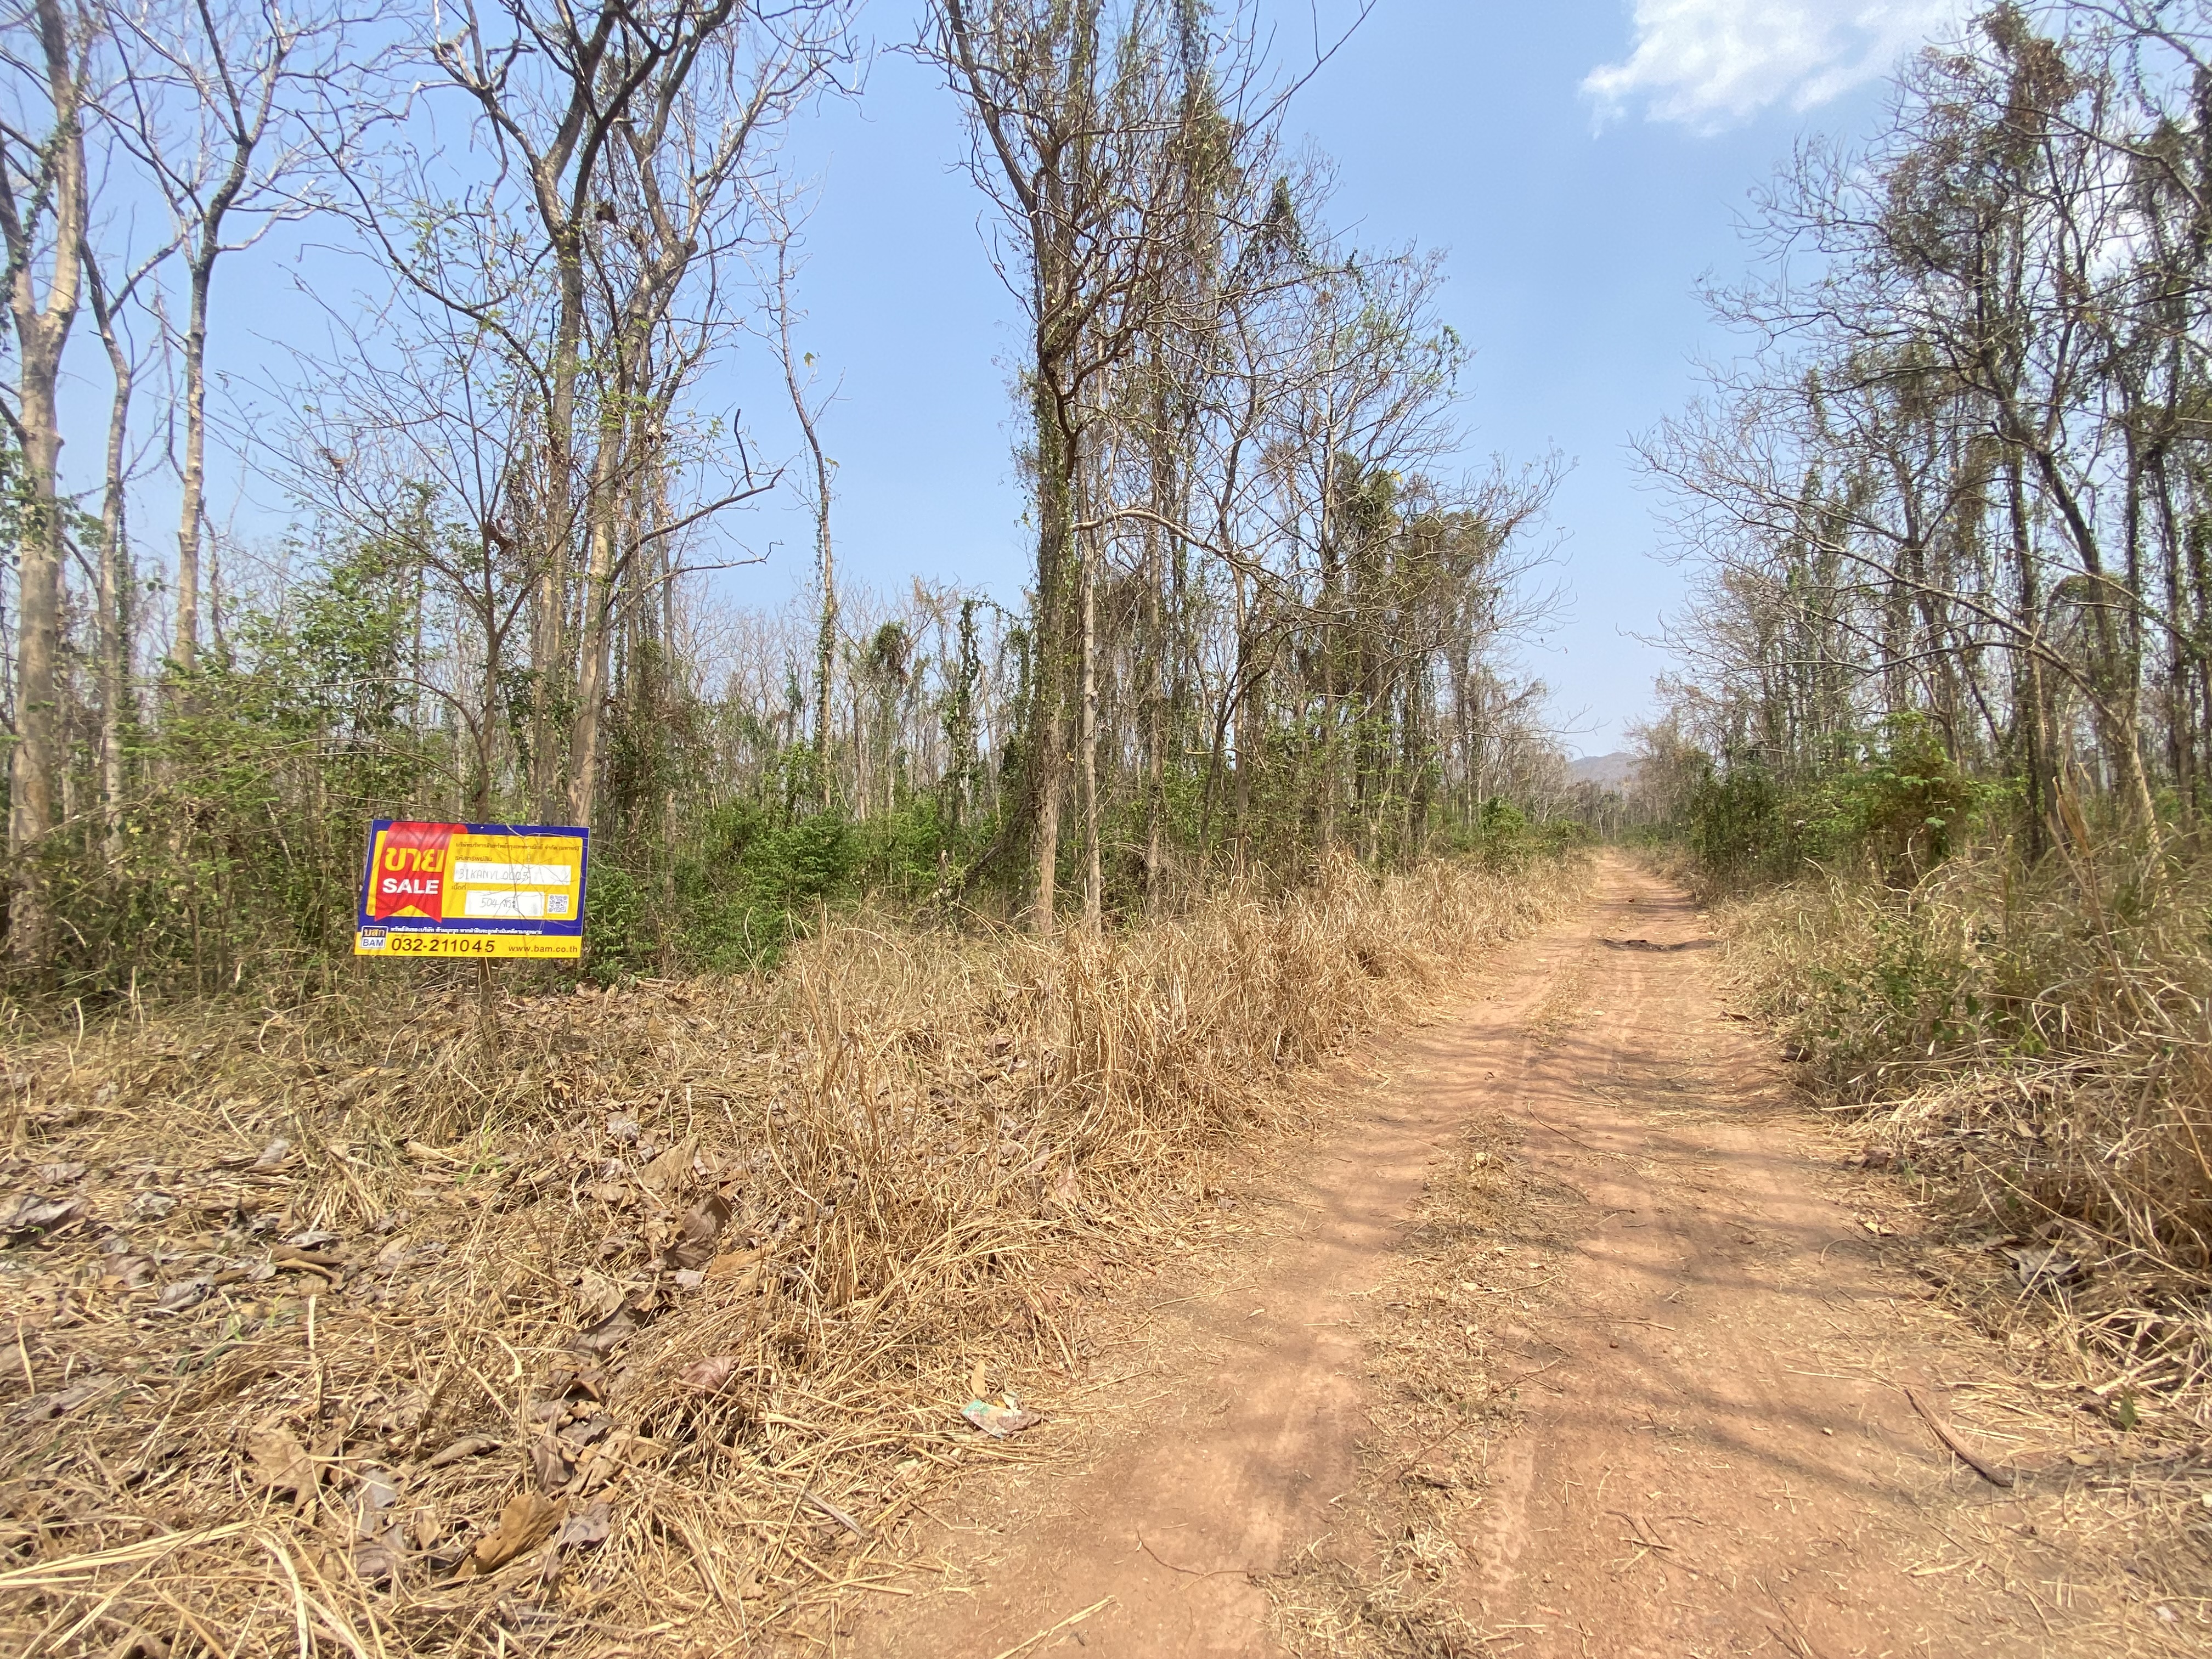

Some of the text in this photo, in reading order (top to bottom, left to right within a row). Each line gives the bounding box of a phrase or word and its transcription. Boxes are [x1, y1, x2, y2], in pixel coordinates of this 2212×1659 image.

[385, 847, 445, 872] ขาย
[382, 878, 439, 895] SALE
[364, 928, 385, 937] บสก
[363, 939, 383, 947] BAM
[392, 938, 578, 953] 032-211045 www.bam.co.th
